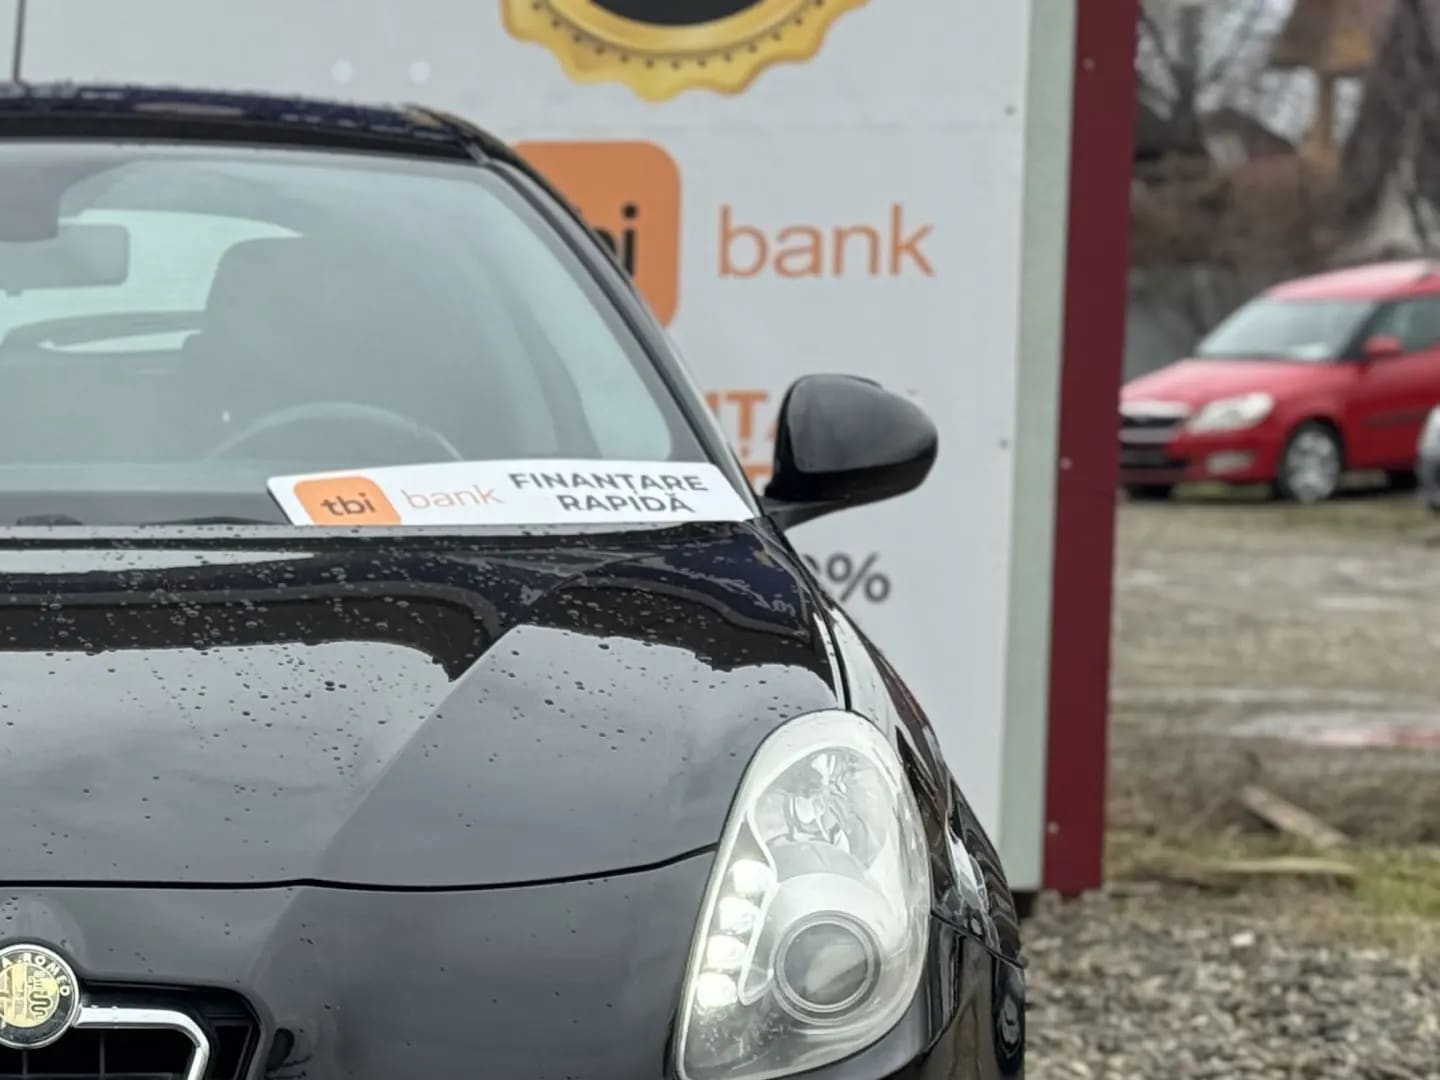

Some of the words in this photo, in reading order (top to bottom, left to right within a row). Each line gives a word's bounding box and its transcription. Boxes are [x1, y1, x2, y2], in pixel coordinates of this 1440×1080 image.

[718, 203, 936, 279] bank
[320, 492, 376, 516] tbi
[400, 484, 504, 510] bank
[22, 952, 71, 997] ROMEO
